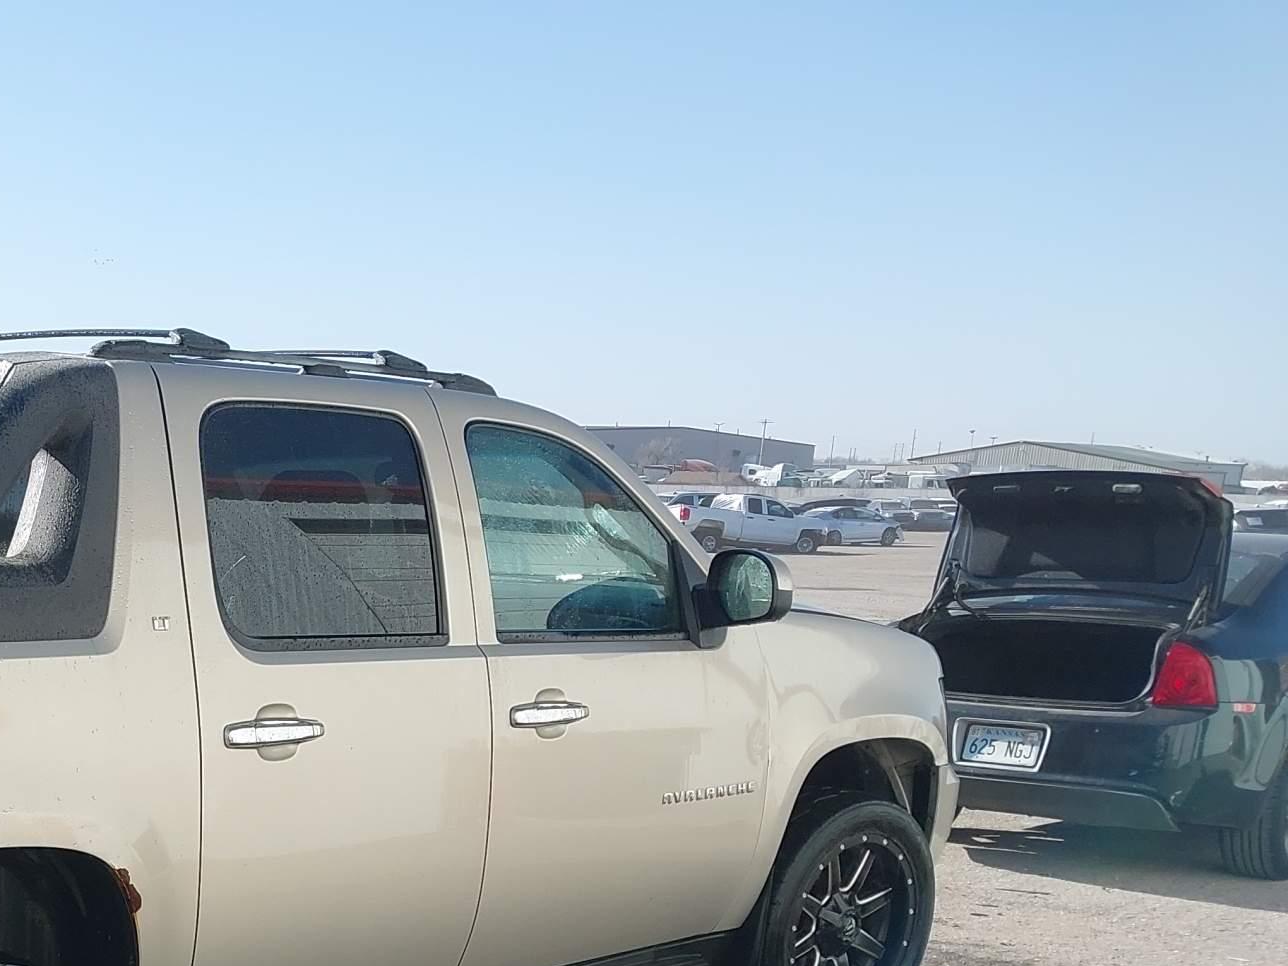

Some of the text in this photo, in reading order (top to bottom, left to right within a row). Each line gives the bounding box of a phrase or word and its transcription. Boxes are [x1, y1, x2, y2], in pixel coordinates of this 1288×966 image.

[969, 738, 1034, 760] 625 NGJ
[661, 780, 757, 805] AVALANCHE
